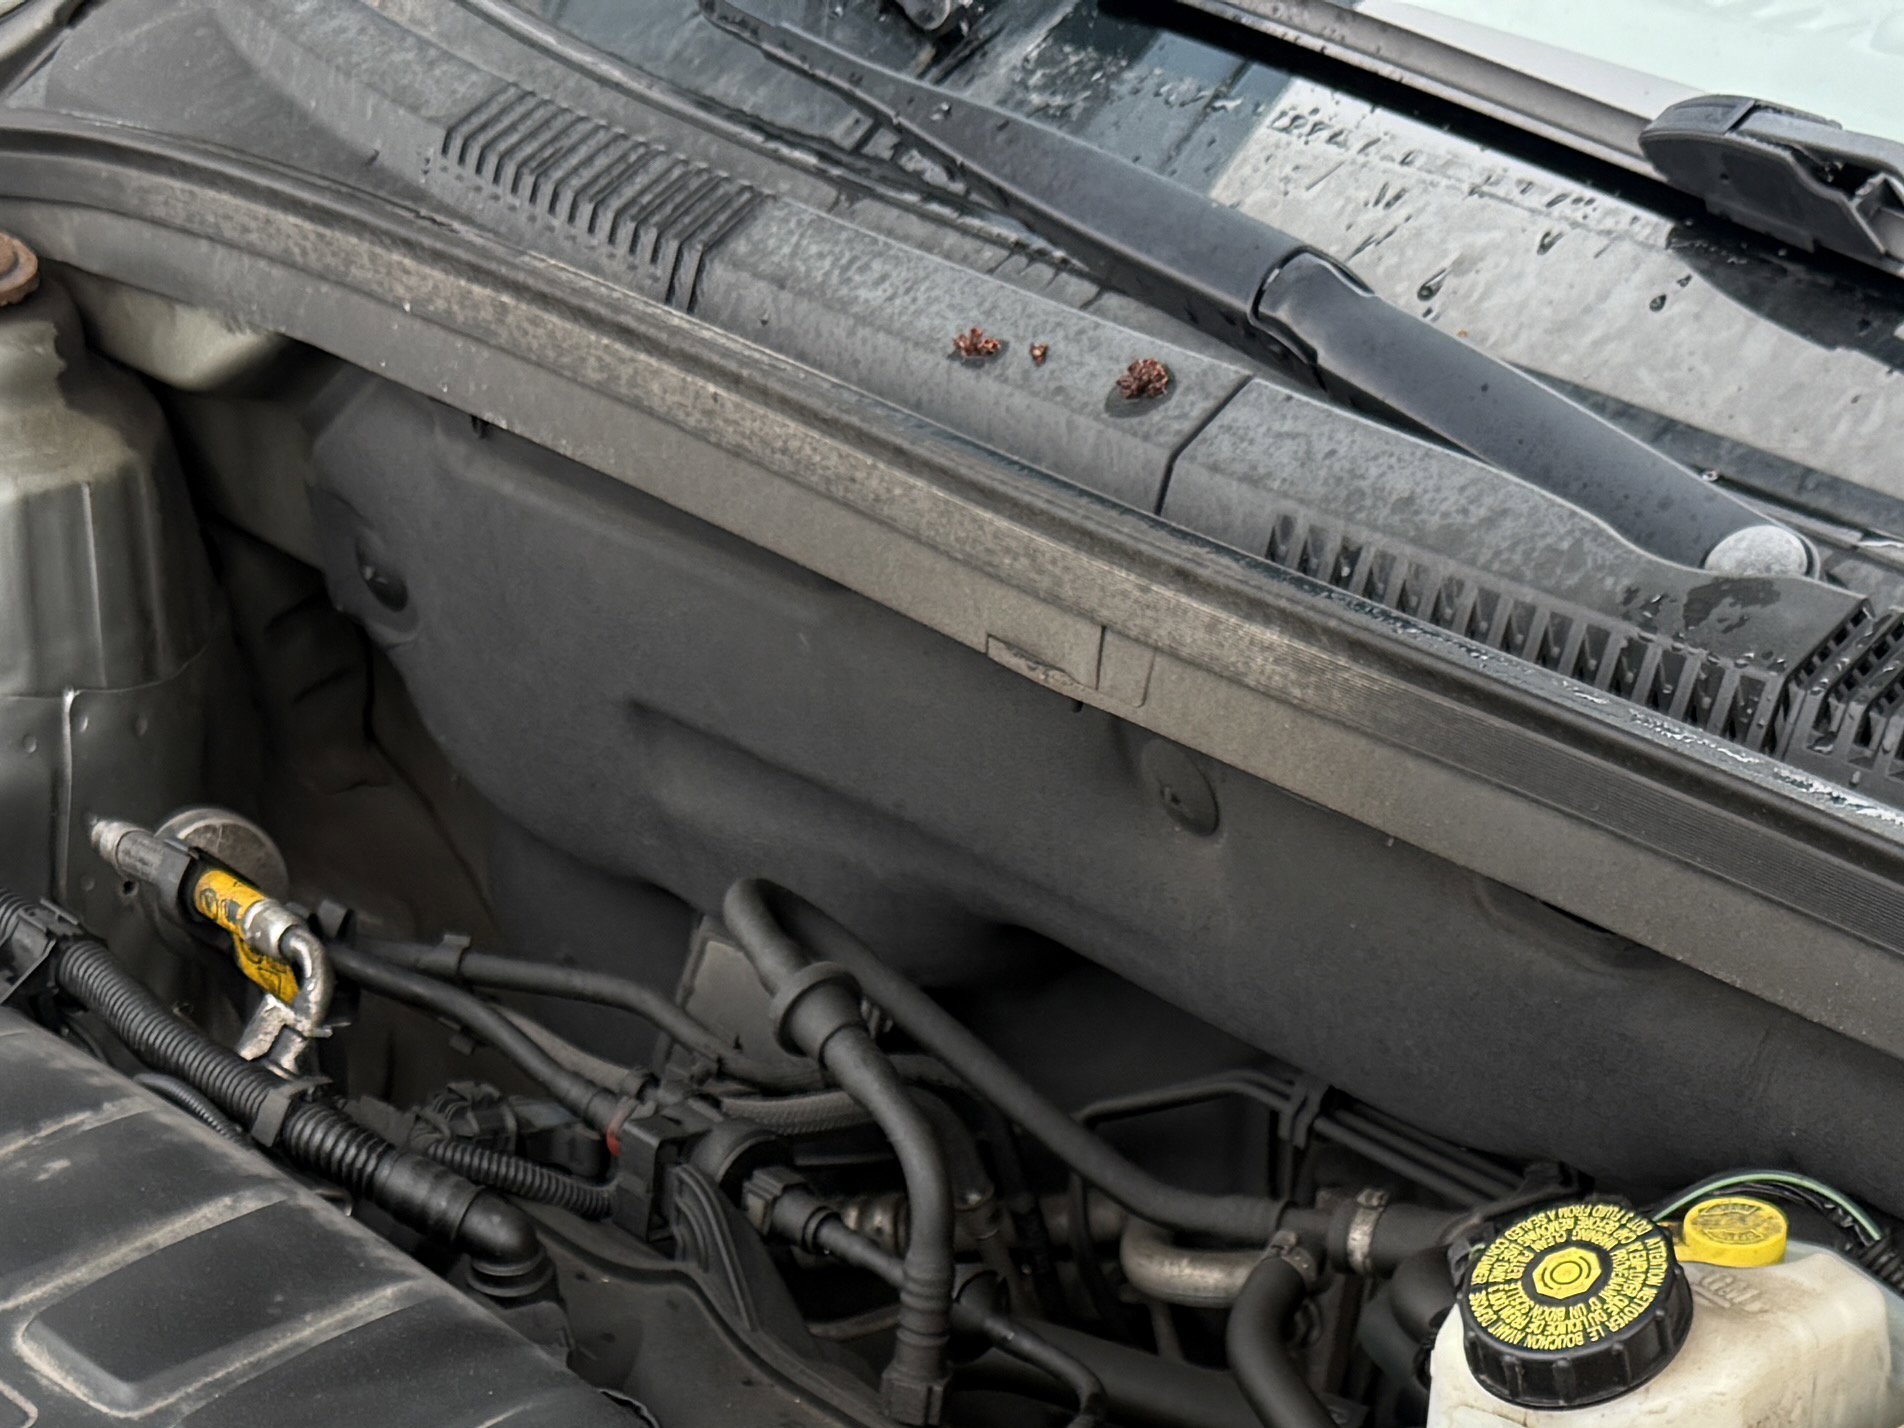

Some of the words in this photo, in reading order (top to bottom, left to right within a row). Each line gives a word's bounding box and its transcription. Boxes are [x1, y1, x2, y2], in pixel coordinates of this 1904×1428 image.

[1557, 1205, 1592, 1218] FROM
[1502, 1213, 1548, 1241] SEALED
[1604, 1286, 1659, 1333] NETTOYER
[1520, 1331, 1584, 1349] BOUCHON
[1586, 1325, 1606, 1341] LE
